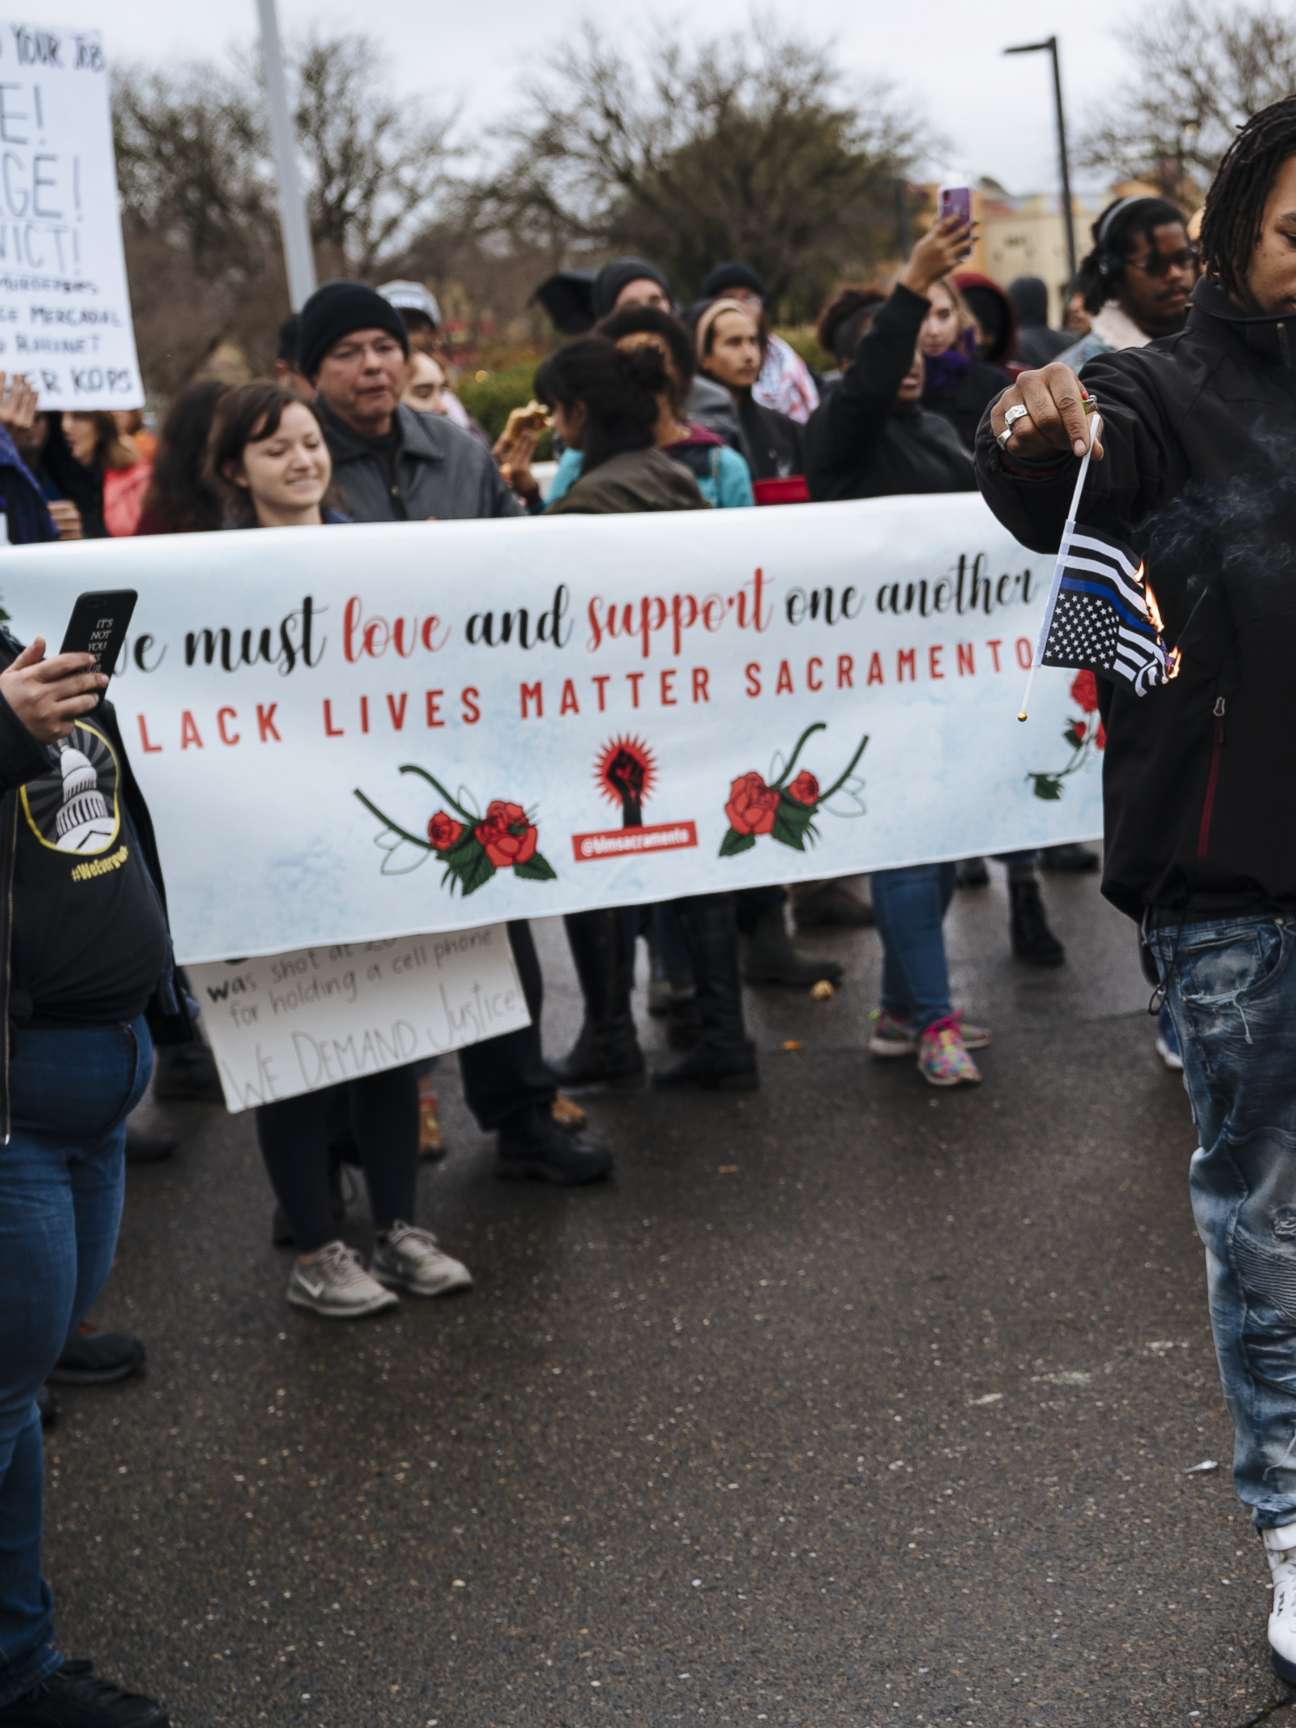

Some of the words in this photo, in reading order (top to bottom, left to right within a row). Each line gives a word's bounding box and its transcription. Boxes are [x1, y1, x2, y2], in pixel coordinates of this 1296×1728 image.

[10, 22, 64, 68] YOUR
[70, 365, 134, 396] KOPS
[90, 629, 113, 641] NOT
[184, 595, 328, 678] must
[341, 594, 450, 665] love
[464, 583, 573, 651] and
[585, 566, 775, 660] support
[784, 583, 864, 627] one
[875, 551, 1040, 619] another
[87, 641, 108, 652] YOU
[322, 685, 482, 739] LIVES
[519, 664, 712, 721] MATTER
[744, 636, 1035, 699] SACRAMENTO
[207, 972, 257, 1004] was
[271, 948, 317, 984] shot
[229, 1001, 259, 1030] for
[268, 968, 358, 1016] holding
[366, 963, 384, 982] a
[392, 948, 428, 975] cell
[433, 927, 494, 969] phone
[222, 1042, 281, 1110] WE
[290, 1017, 420, 1088] DEMAND
